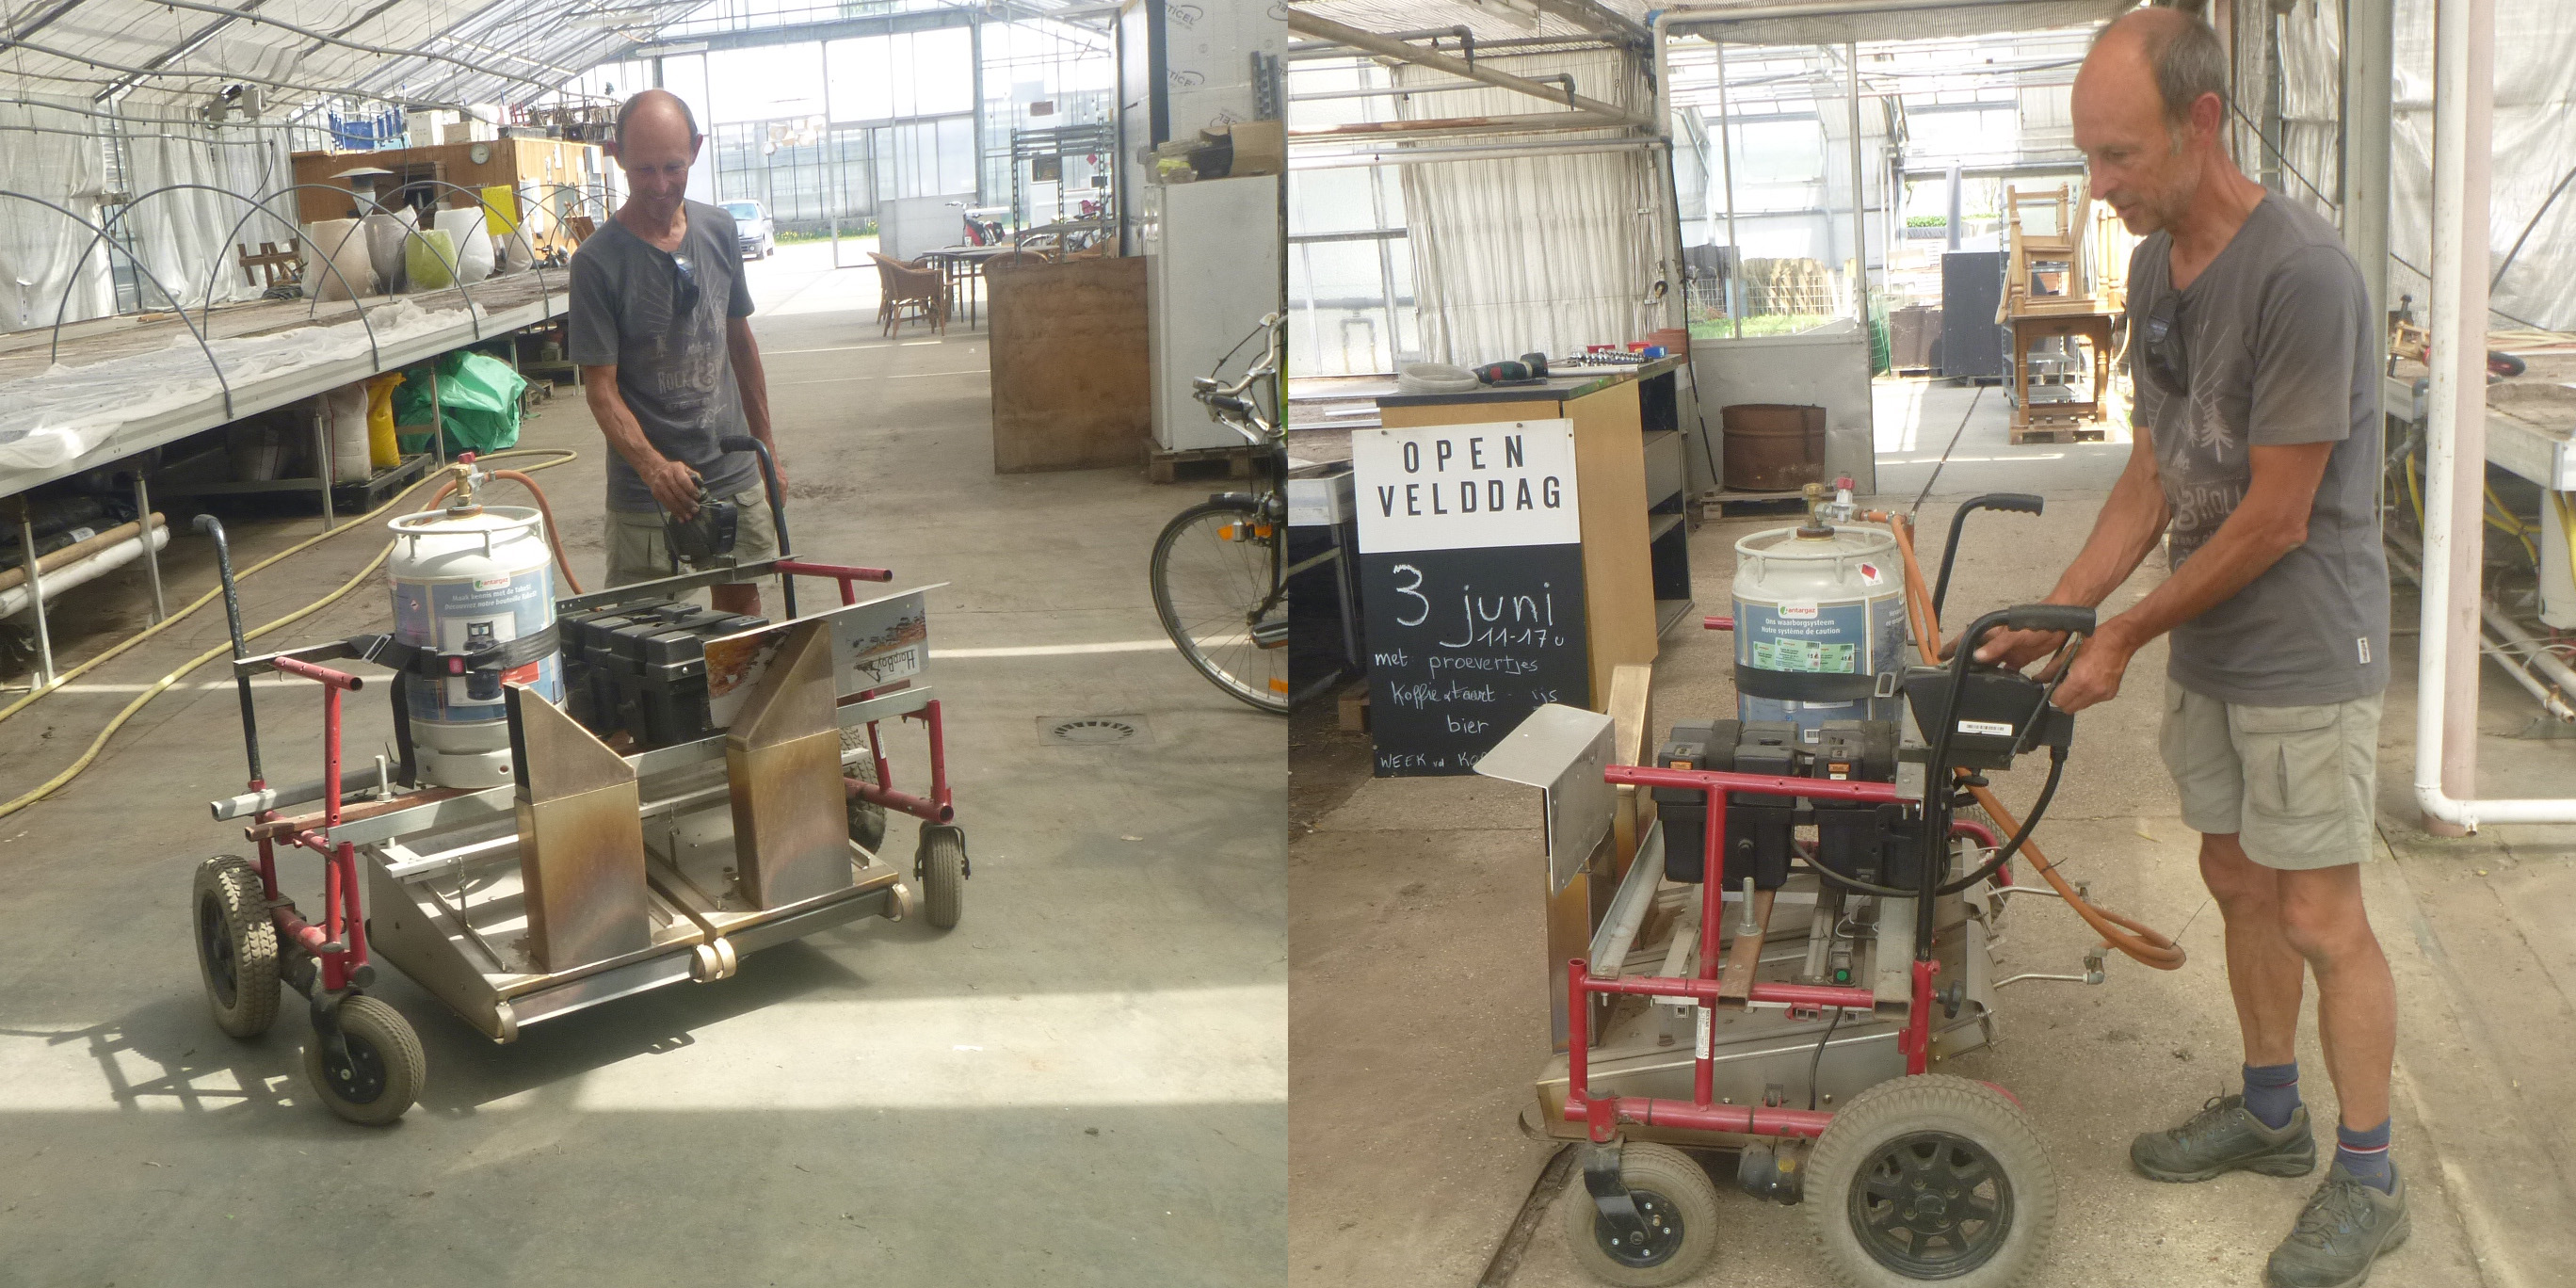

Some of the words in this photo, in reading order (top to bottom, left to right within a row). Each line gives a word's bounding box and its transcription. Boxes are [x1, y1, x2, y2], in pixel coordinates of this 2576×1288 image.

[1403, 434, 1524, 474] OPEN
[1377, 475, 1561, 518] VELDDAG
[482, 577, 508, 586] antargaz
[1393, 563, 1430, 627] 3
[1439, 582, 1554, 648] juni
[1777, 618, 1835, 628] waarborgsysteem
[1778, 626, 1804, 636] système
[1375, 648, 1409, 668] met
[1428, 653, 1538, 680] proevertjes
[1446, 714, 1489, 734] bier
[1380, 753, 1426, 769] WEEK
